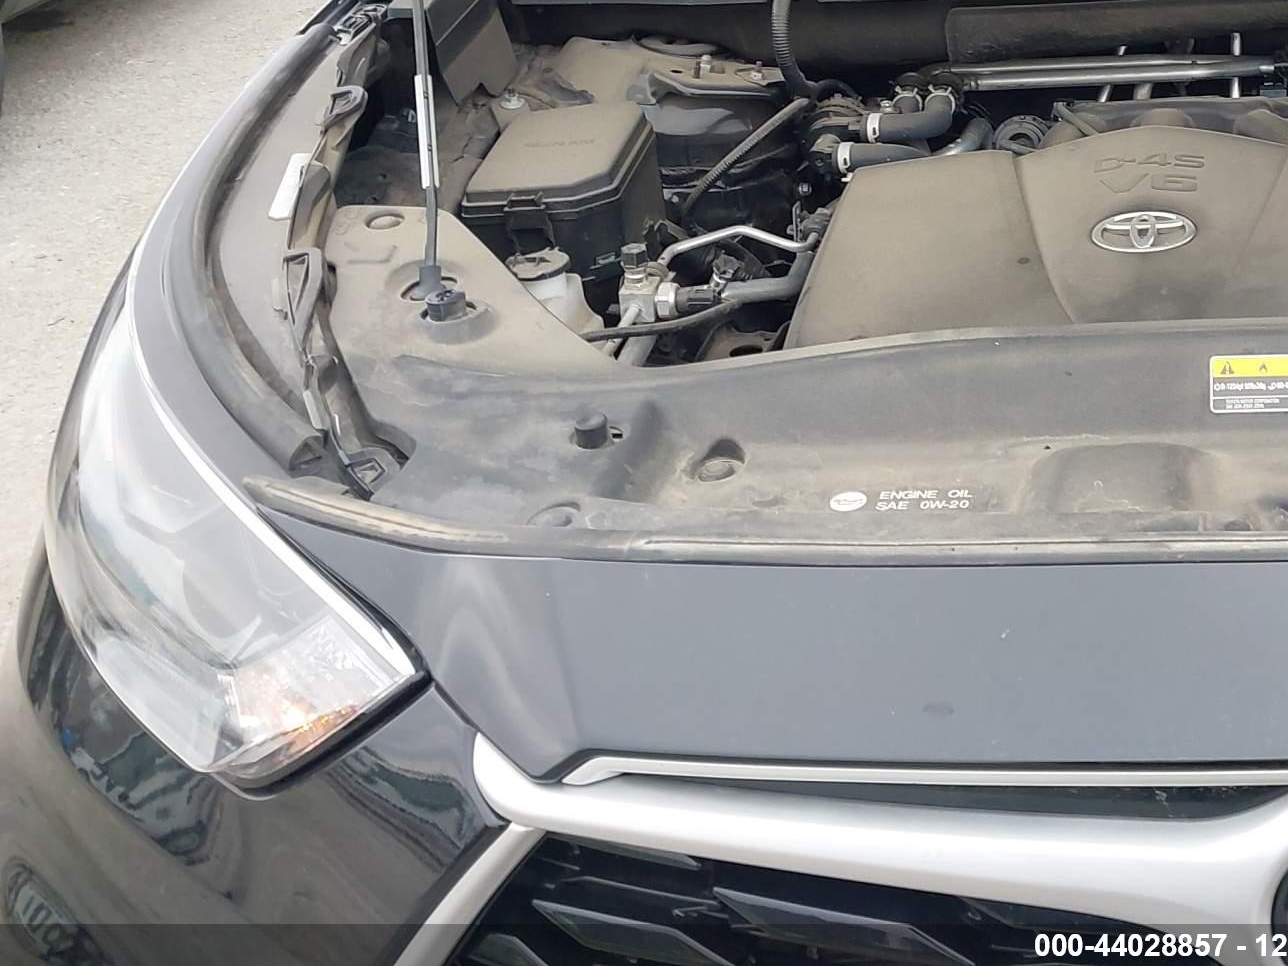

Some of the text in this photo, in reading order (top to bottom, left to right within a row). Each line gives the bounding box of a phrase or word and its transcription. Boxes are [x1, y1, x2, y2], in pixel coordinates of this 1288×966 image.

[1094, 152, 1206, 173] D-4S
[1098, 173, 1198, 194] V6
[879, 489, 974, 500] ENGINE OIL
[875, 501, 910, 511] SAE
[919, 499, 971, 510] 0W-20
